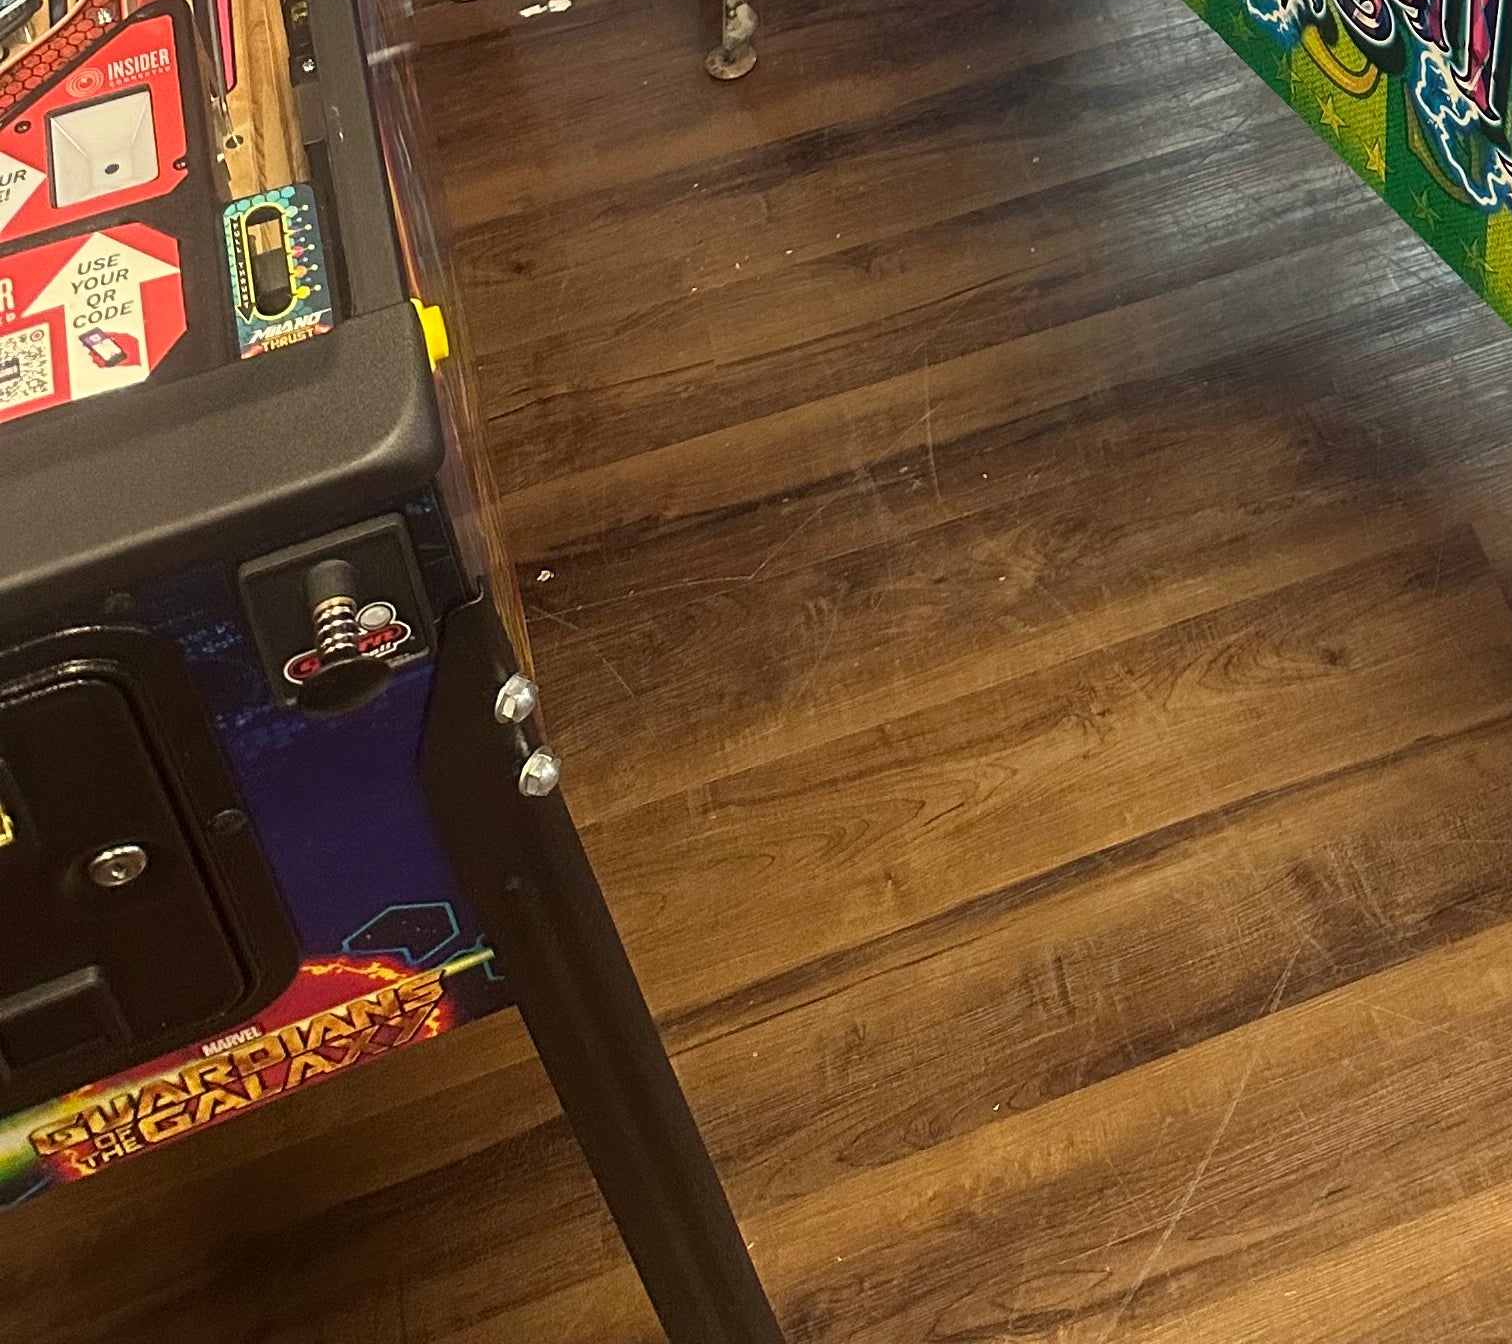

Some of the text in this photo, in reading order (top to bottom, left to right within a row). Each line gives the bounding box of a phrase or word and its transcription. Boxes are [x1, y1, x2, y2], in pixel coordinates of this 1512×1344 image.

[106, 48, 171, 81] INSIDER
[77, 253, 121, 275] USE
[71, 268, 130, 296] YOUR
[72, 299, 135, 330] CODE
[86, 288, 117, 310] QR
[260, 326, 317, 353] THRUST
[202, 1024, 262, 1058] MARVEL
[28, 968, 448, 1160] GUARDIANS
[138, 1002, 435, 1147] GALAXY
[82, 1138, 143, 1171] THE
[97, 1128, 134, 1152] OF
